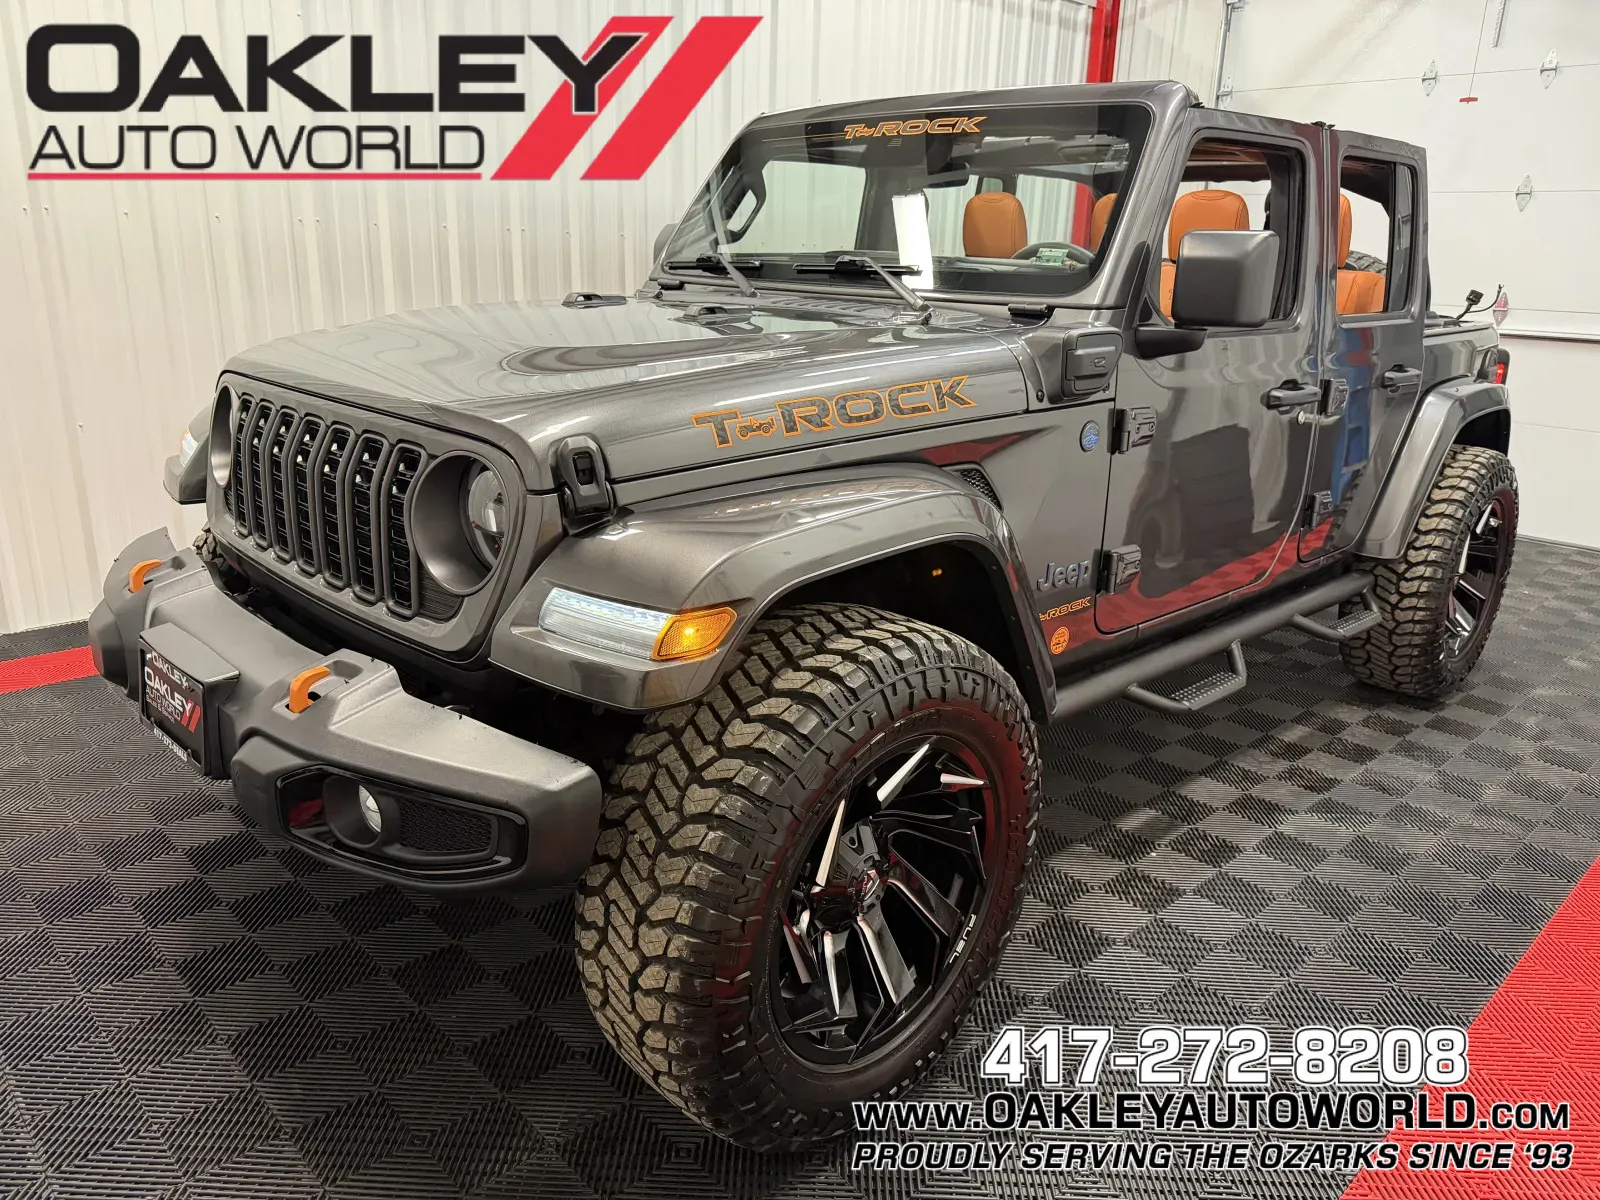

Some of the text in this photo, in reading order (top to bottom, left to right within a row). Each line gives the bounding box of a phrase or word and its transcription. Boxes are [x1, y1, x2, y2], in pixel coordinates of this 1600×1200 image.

[1037, 560, 1090, 592] Jeep
[145, 666, 192, 716] OAKLEY
[152, 650, 187, 690] OAKLEY
[949, 913, 977, 964] FUEL
